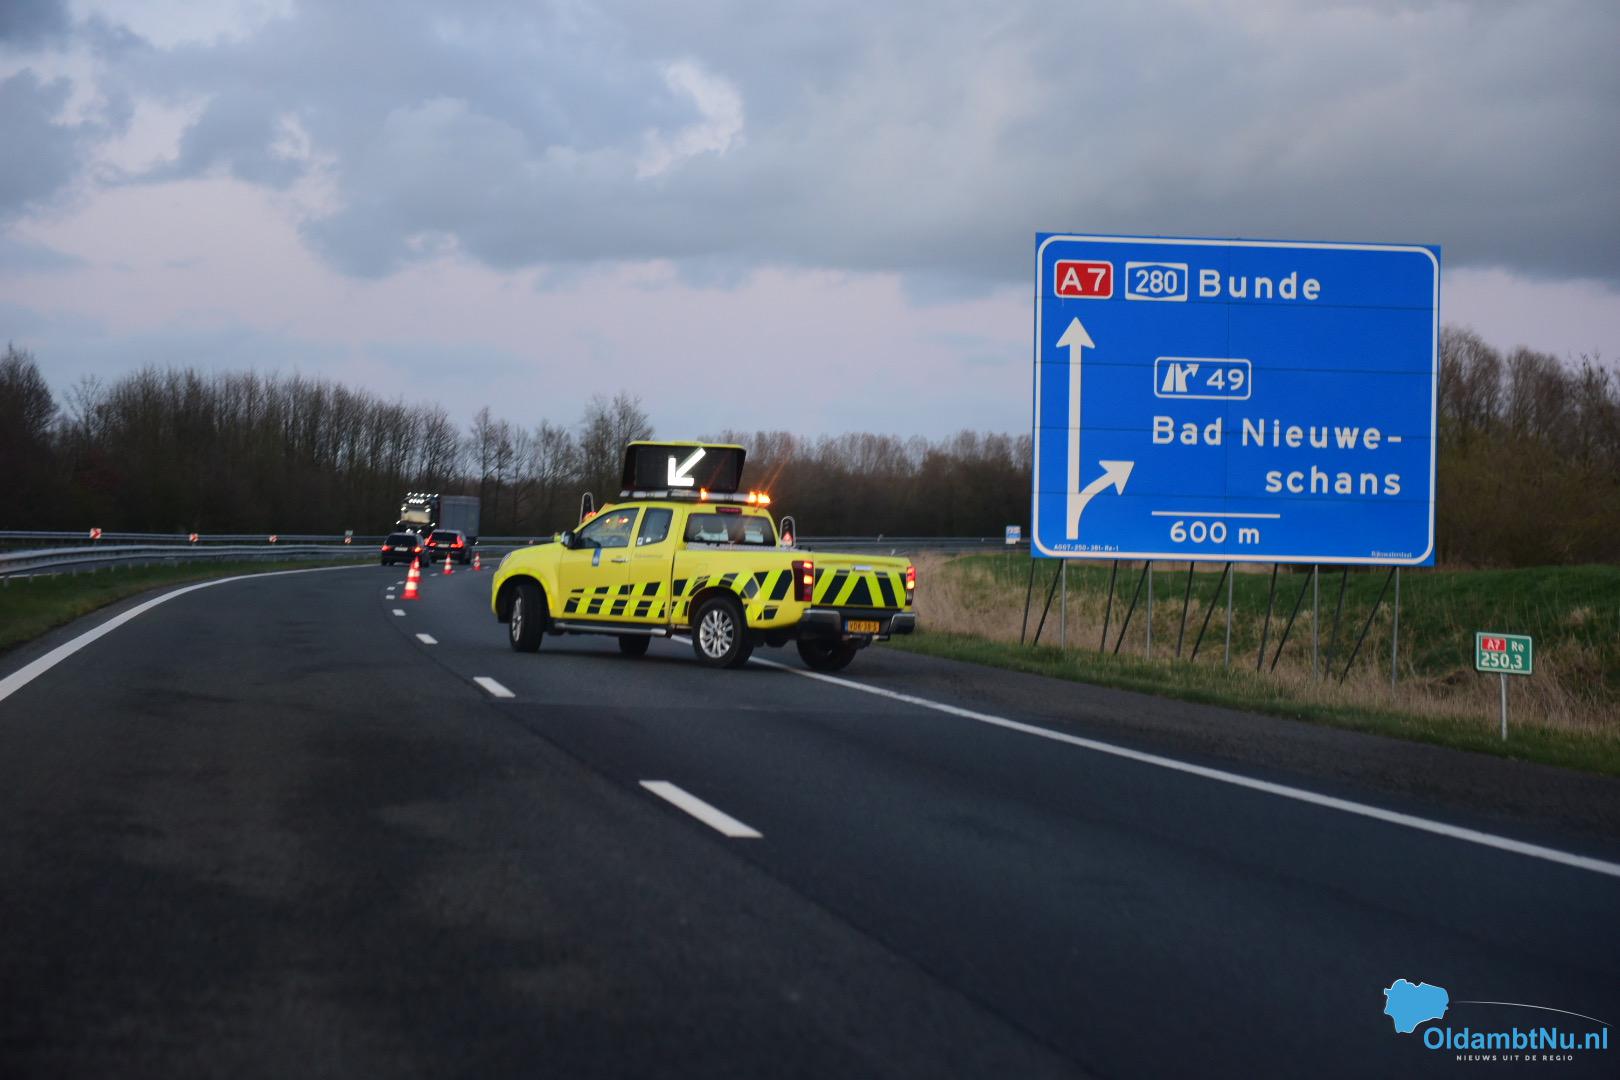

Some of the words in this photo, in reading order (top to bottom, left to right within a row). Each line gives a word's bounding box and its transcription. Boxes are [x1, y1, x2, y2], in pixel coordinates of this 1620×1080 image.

[1135, 269, 1178, 294] 280
[1199, 269, 1322, 300] Bunde
[1206, 368, 1245, 391] 49
[1152, 415, 1222, 446] Bad
[1242, 417, 1402, 450] Nieuwe-
[1265, 464, 1402, 496] schans
[1169, 520, 1228, 544] 600
[1238, 527, 1260, 545] m
[1487, 638, 1501, 650] A7
